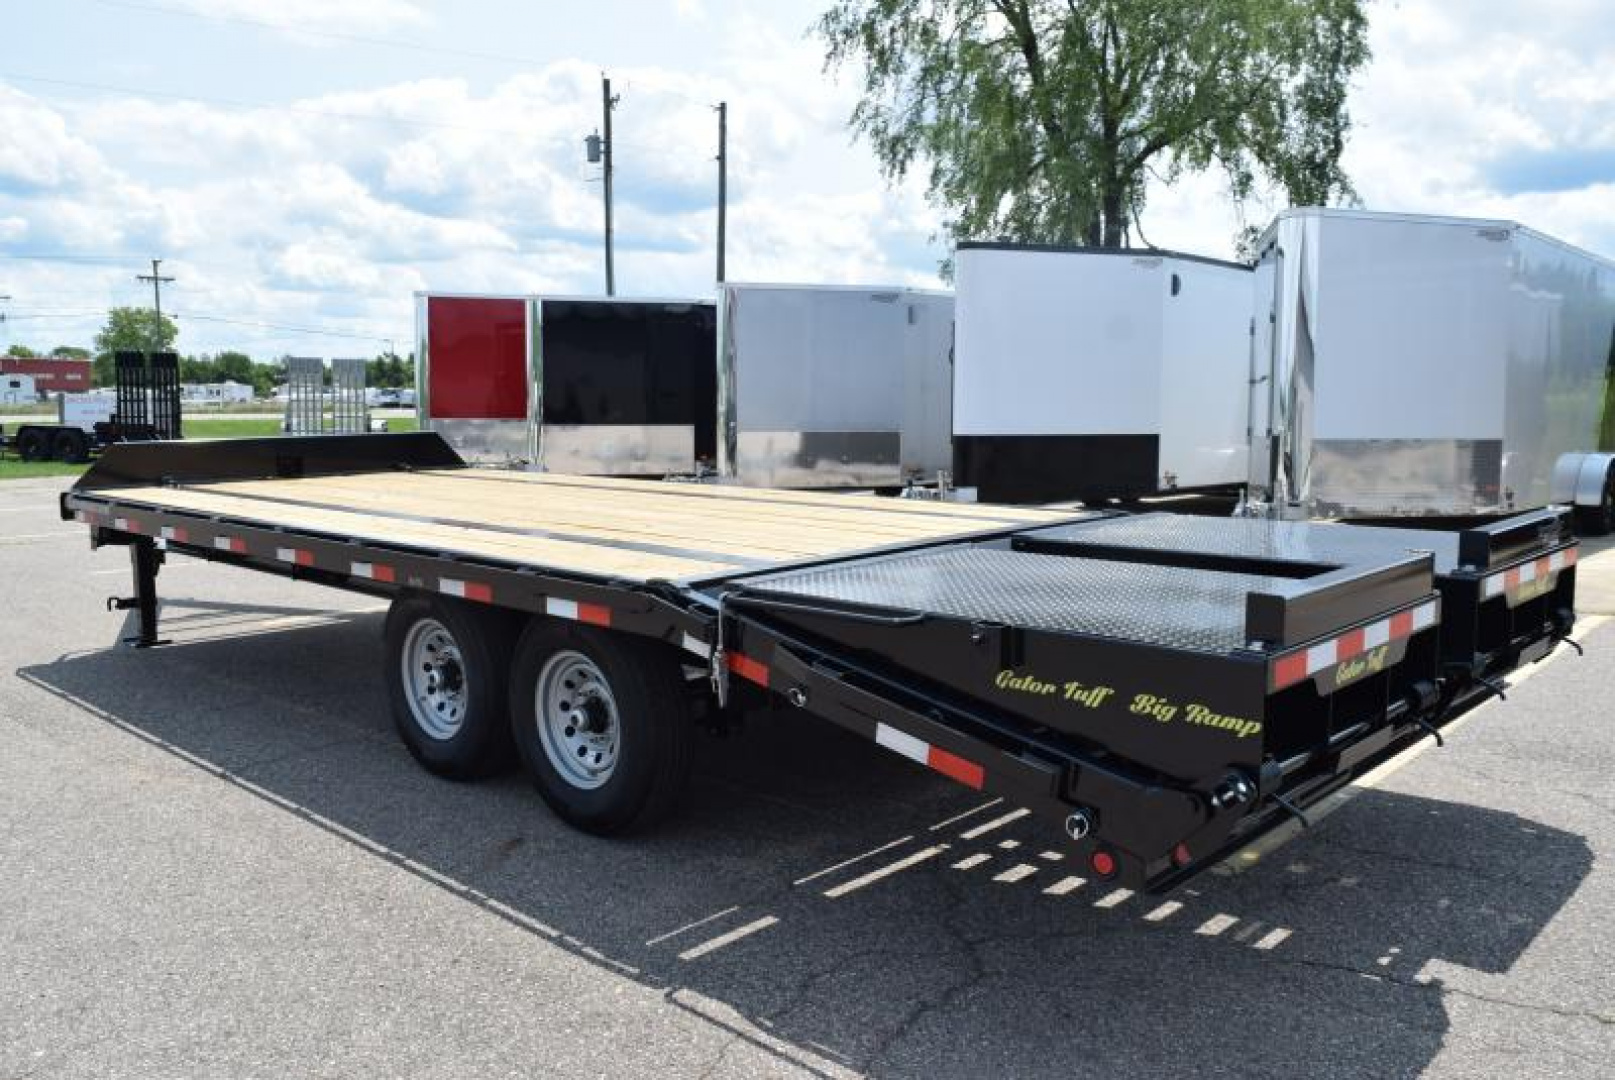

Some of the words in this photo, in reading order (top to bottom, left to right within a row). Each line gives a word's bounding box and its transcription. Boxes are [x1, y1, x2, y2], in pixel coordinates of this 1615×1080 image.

[995, 669, 1056, 695] Gator
[1063, 681, 1115, 708] Tuff
[1129, 693, 1177, 722] Big
[1184, 703, 1262, 738] Ramp
